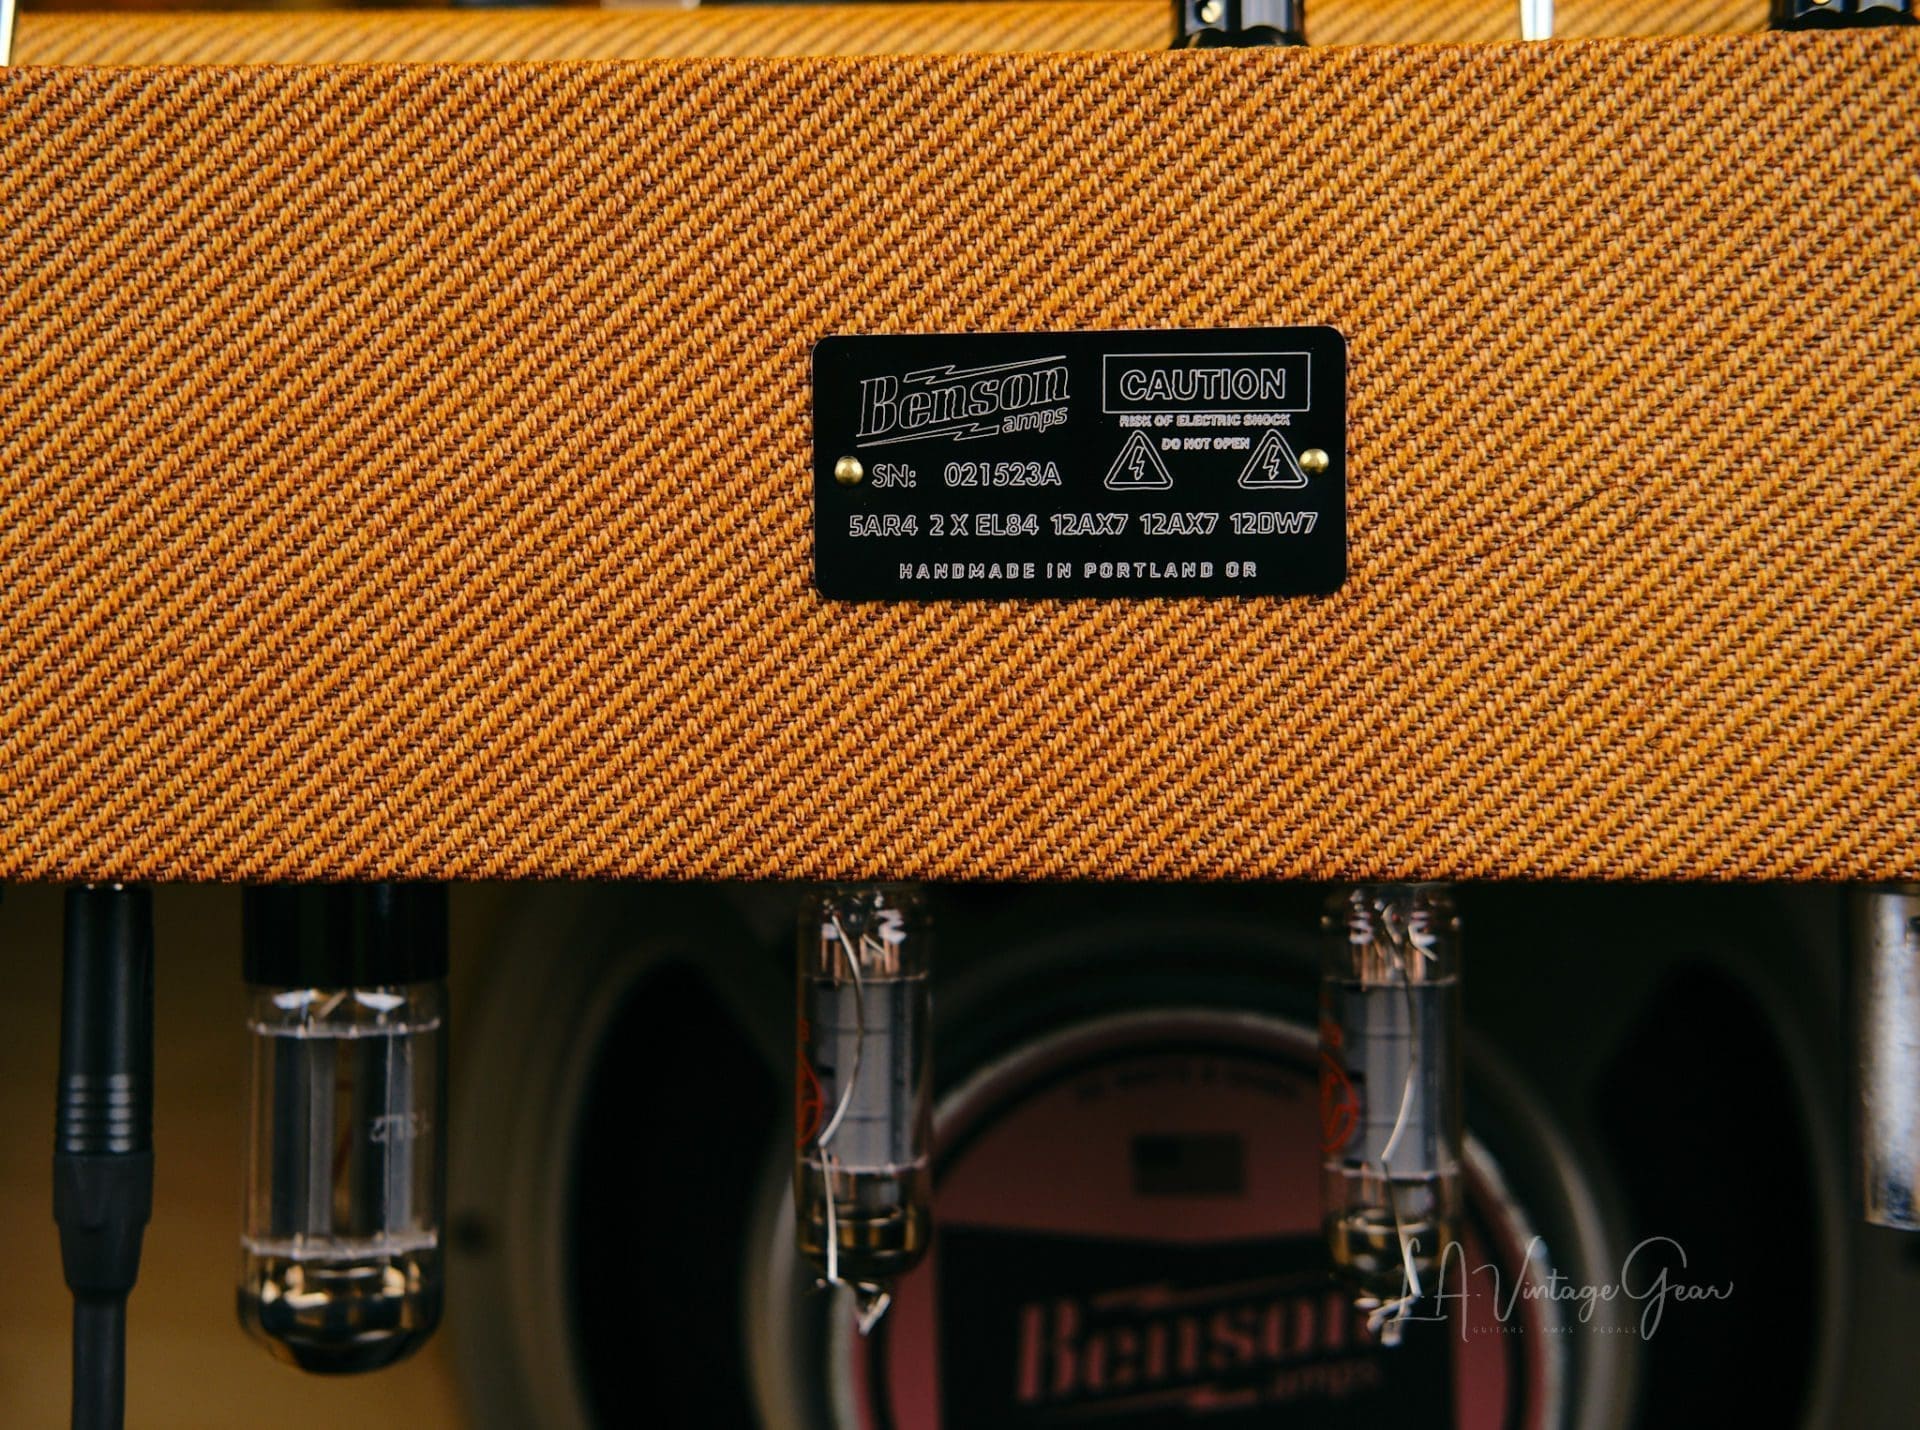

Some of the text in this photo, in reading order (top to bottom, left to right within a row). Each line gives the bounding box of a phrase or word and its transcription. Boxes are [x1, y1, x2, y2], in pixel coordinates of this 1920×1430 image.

[1120, 368, 1286, 401] CAUTION
[856, 366, 1071, 437] Benson
[1002, 406, 1068, 433] amps
[1119, 413, 1291, 428] RISK OF ELECTRIC SHOCK
[1161, 436, 1251, 450] DO NOT OPEN
[872, 462, 1063, 488] SN: 021523A
[849, 511, 1318, 537] 5AR4 2 X EL84 12AX7 12AX7 12DW7
[899, 561, 1257, 579] HANDMADE IN PORTLAND OR
